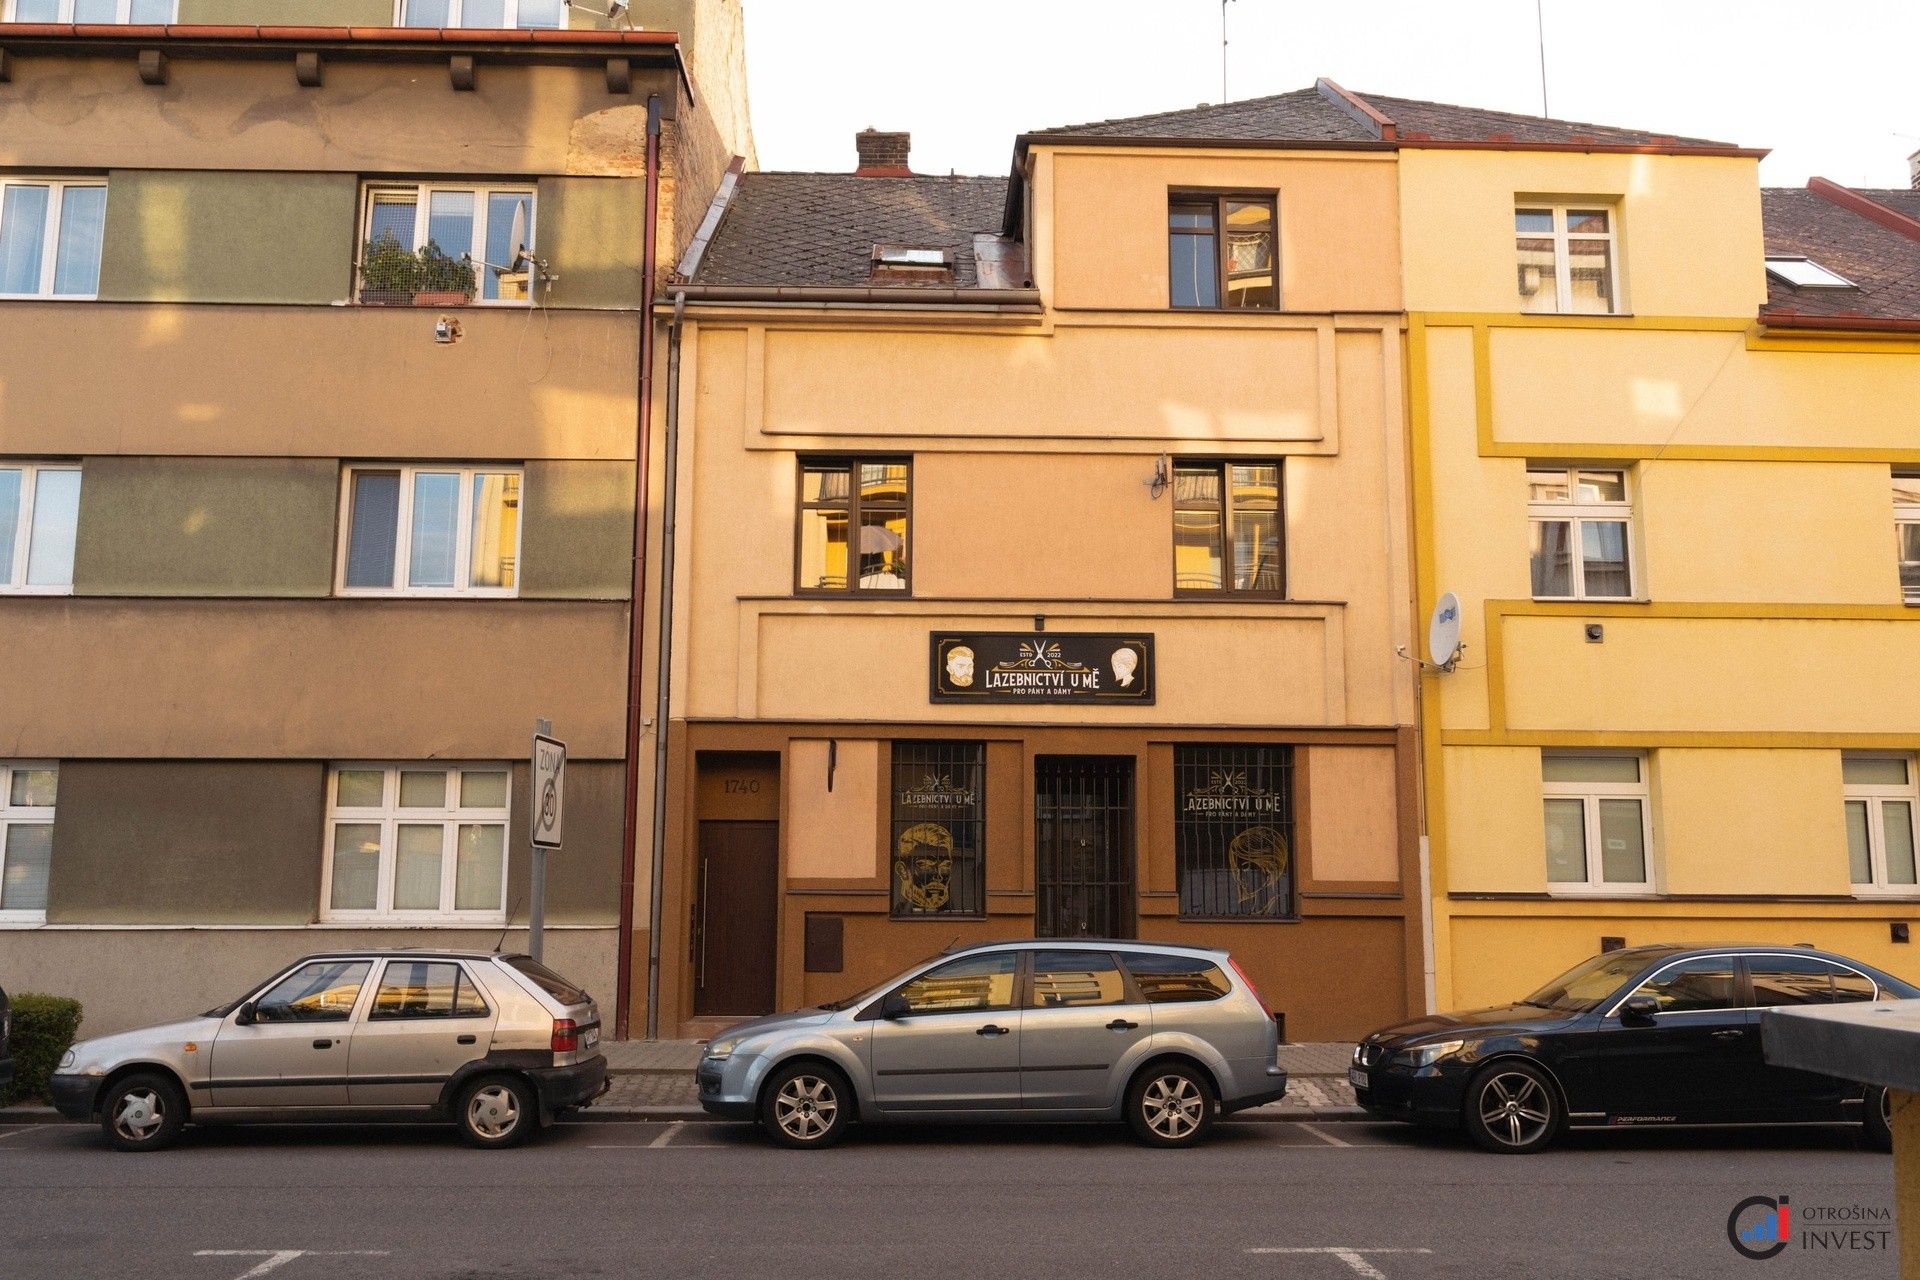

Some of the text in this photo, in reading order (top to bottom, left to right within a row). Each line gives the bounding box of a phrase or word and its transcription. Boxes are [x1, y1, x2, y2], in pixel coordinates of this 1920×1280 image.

[986, 668, 1100, 689] LAZEBNICTVÍ U MĚ
[725, 779, 760, 794] 1740
[544, 792, 555, 817] 30
[956, 794, 962, 804] U
[1255, 798, 1263, 810] U
[1265, 793, 1281, 812] MĚ
